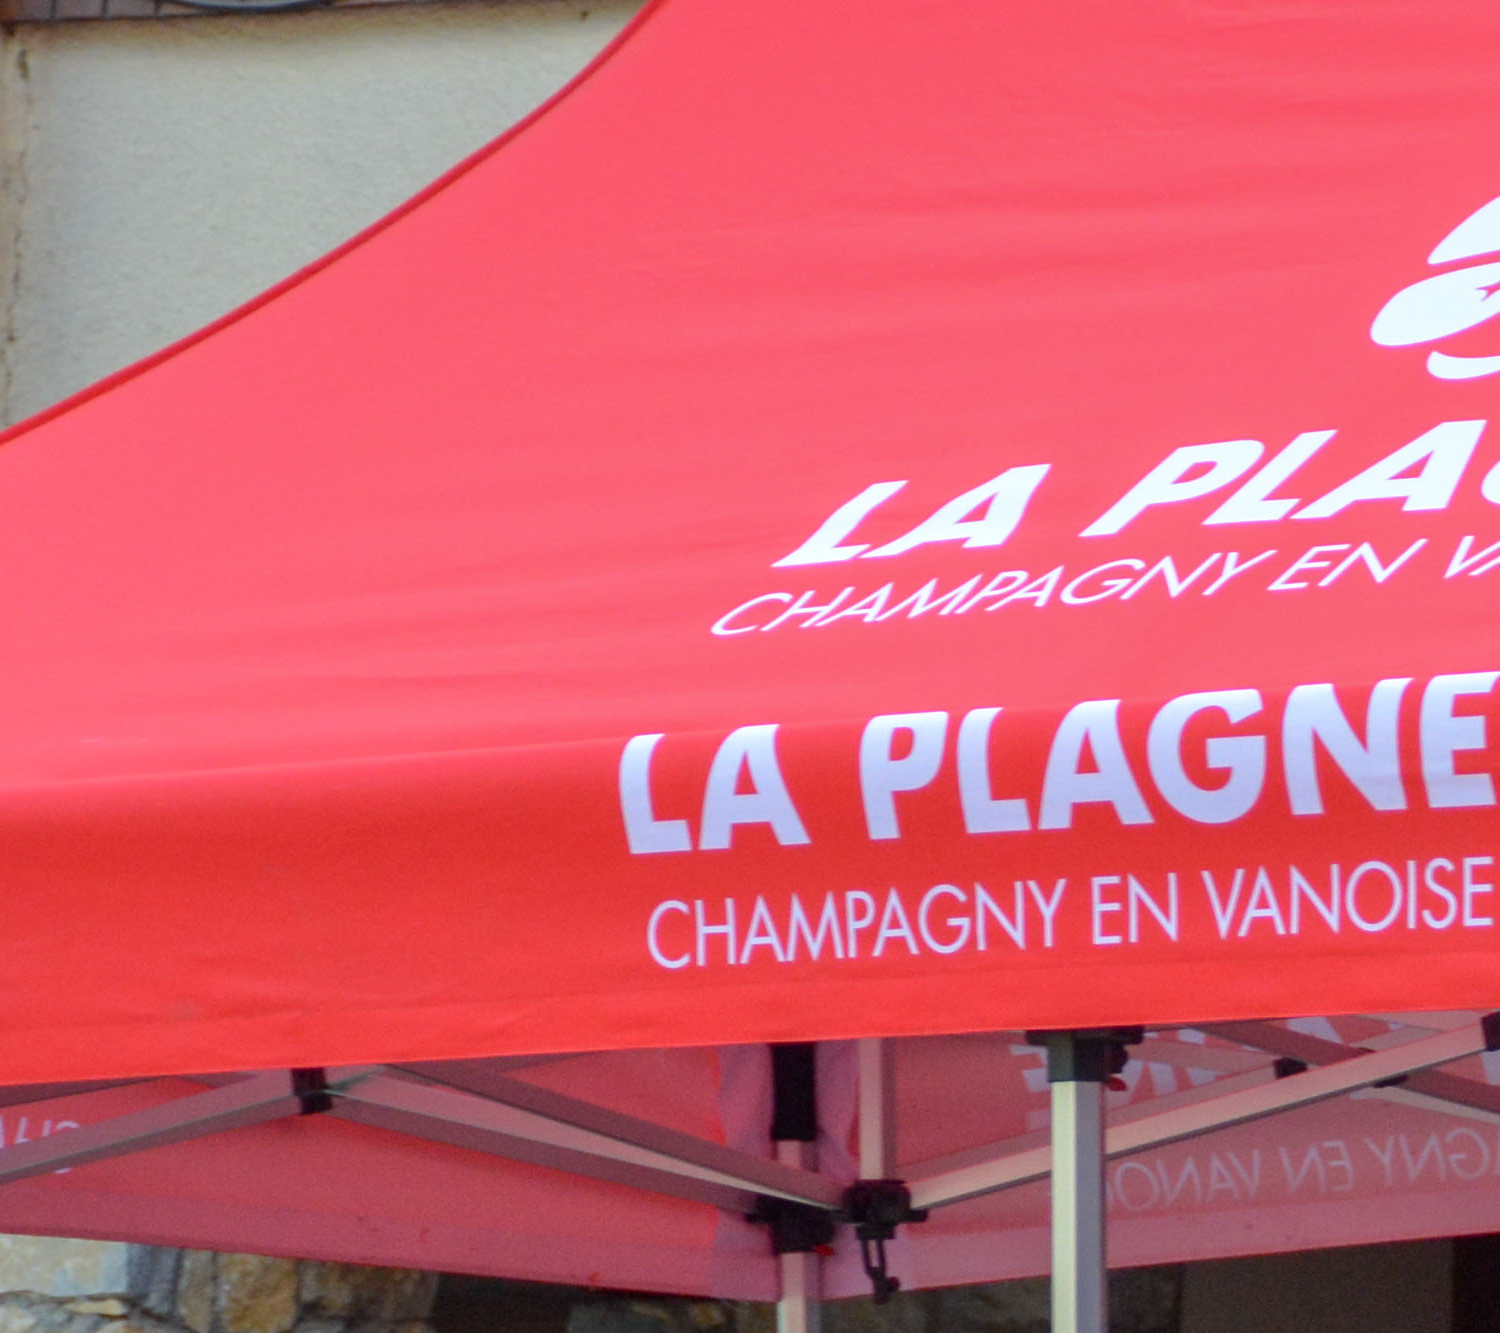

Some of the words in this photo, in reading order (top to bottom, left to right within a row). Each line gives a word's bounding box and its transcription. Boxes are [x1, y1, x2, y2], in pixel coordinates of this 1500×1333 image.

[771, 464, 1052, 568] LA
[708, 549, 1278, 637] CHAMPAGNY
[1266, 536, 1430, 590] EN
[619, 724, 810, 855] LA
[647, 875, 1067, 970] CHAMPAGNY
[1090, 873, 1178, 946] EN
[1202, 856, 1495, 939] VANOISE
